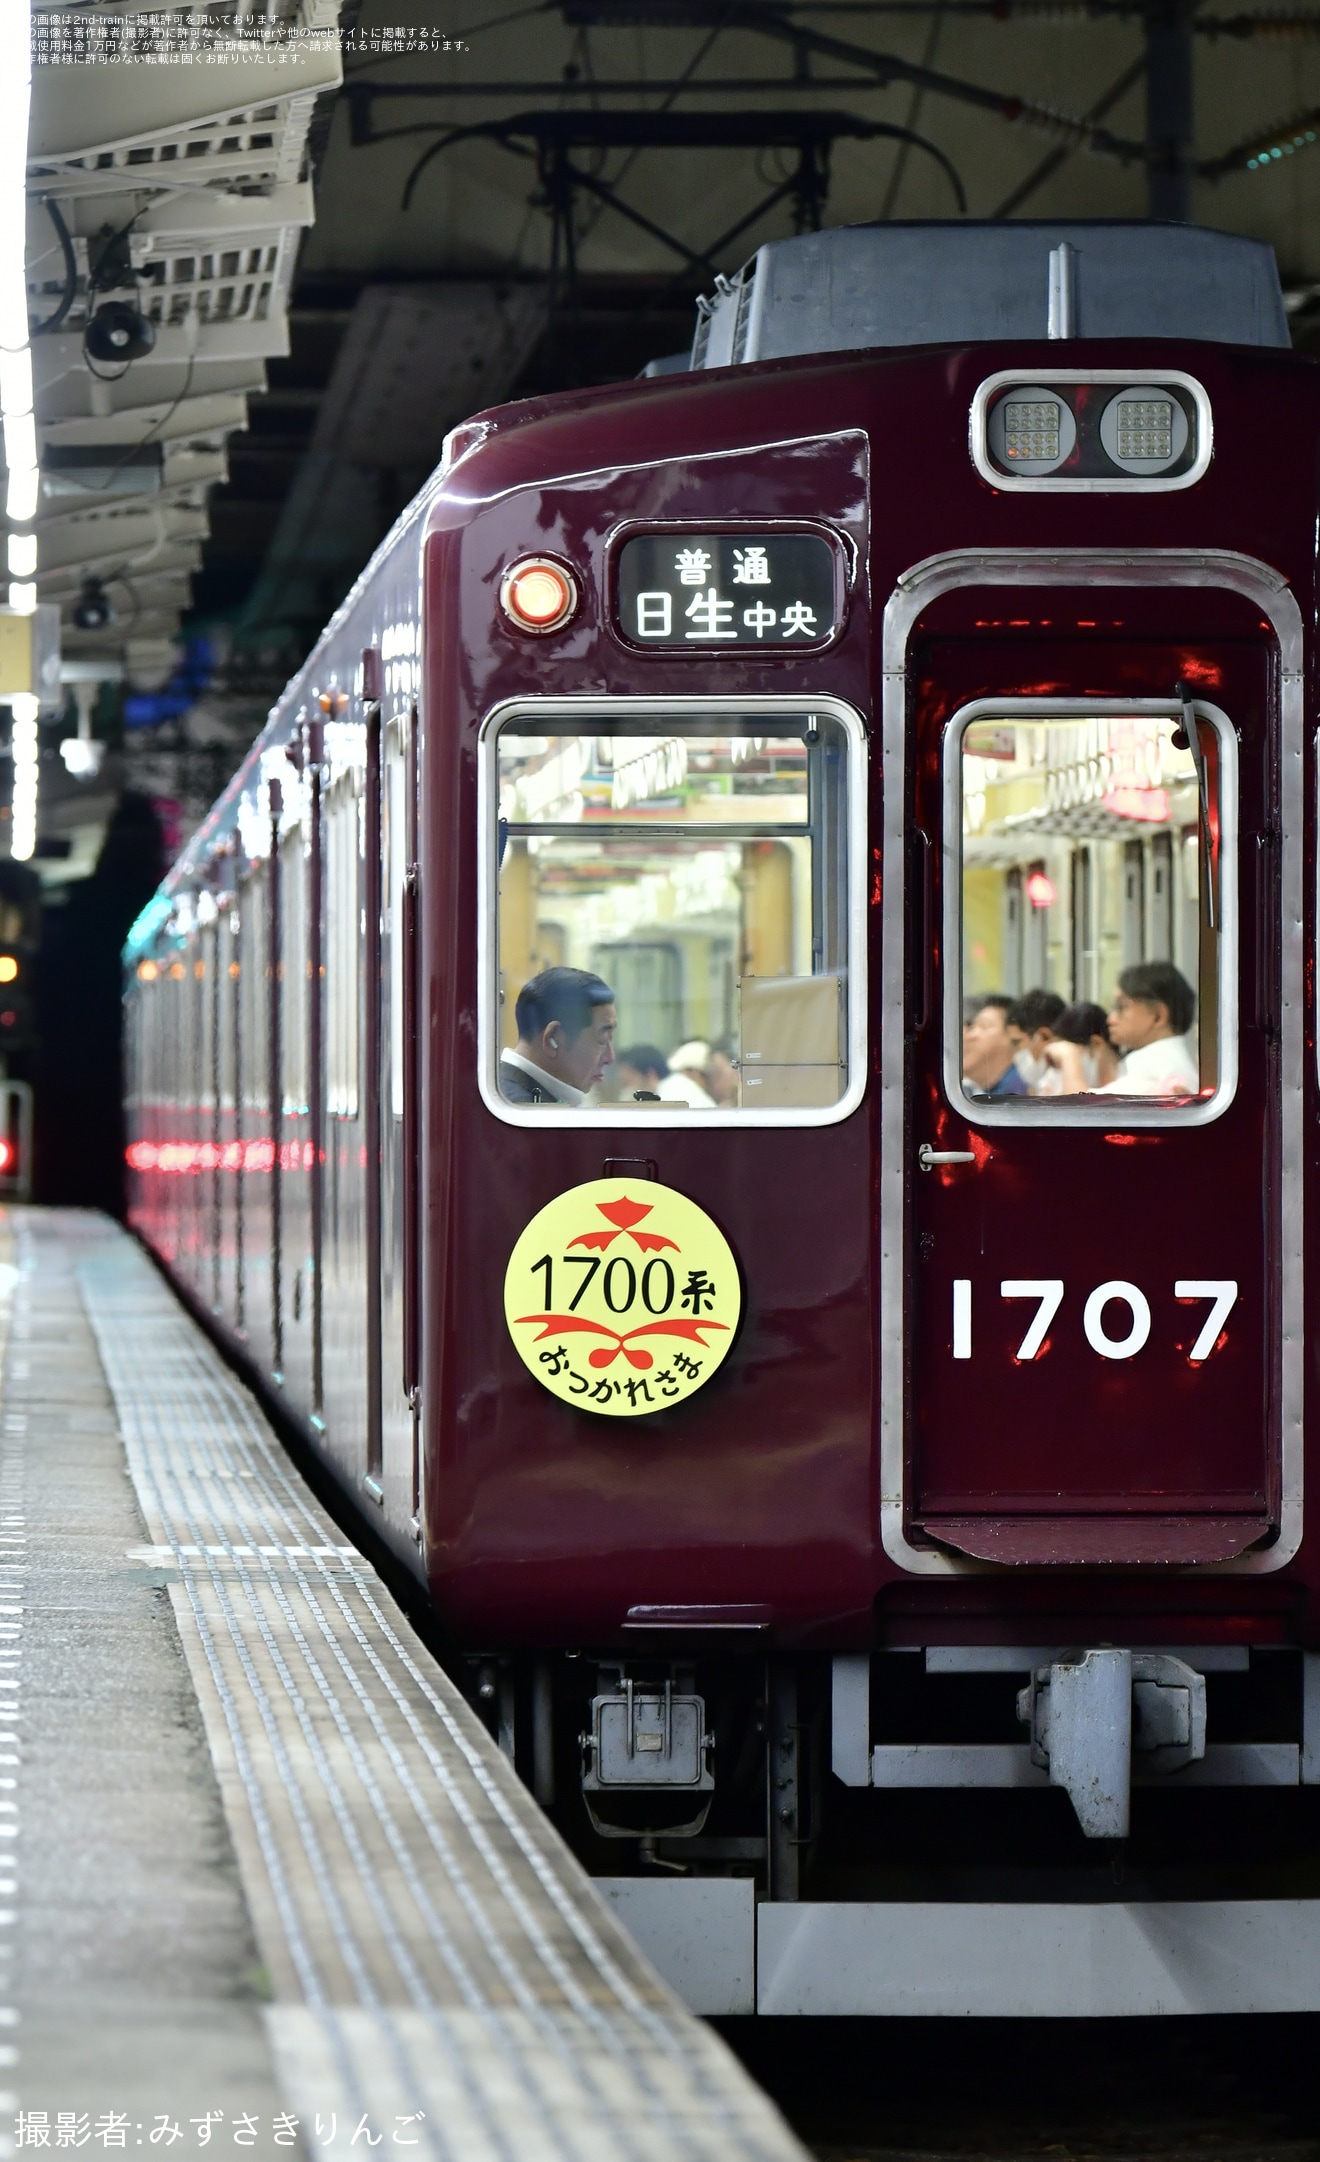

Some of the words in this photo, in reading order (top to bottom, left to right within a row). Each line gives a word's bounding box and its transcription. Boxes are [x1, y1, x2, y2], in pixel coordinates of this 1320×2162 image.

[674, 547, 771, 585] 普通
[637, 587, 818, 639] 日生中央
[530, 1254, 716, 1315] 1700系
[953, 1279, 1238, 1360] 1707
[539, 1345, 704, 1407] おつかれさま
